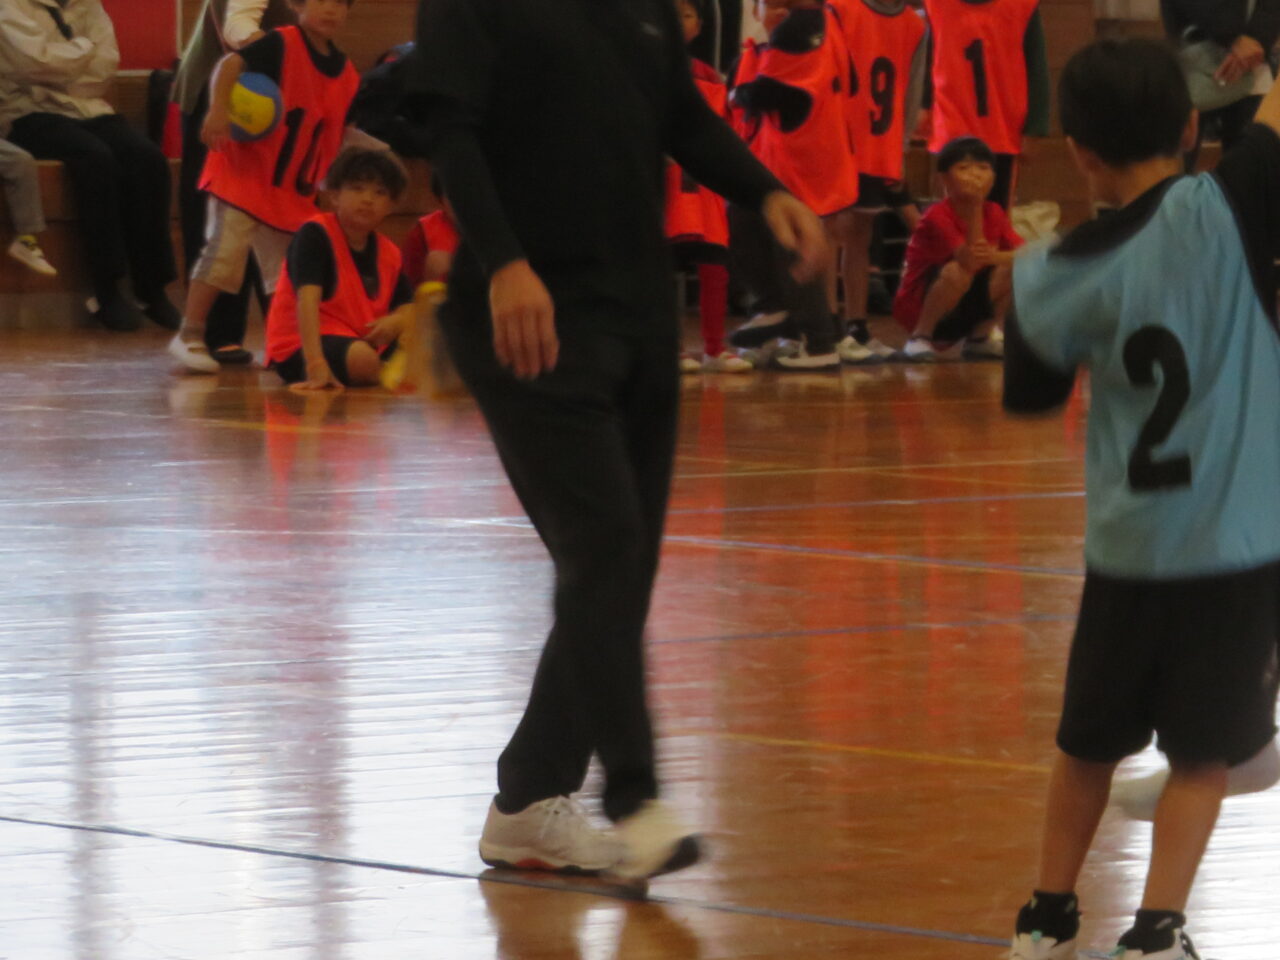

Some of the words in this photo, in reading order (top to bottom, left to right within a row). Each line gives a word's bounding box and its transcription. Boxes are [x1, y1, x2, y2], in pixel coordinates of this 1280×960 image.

[869, 56, 895, 136] 9
[966, 40, 988, 117] 1
[1124, 324, 1192, 494] 2
